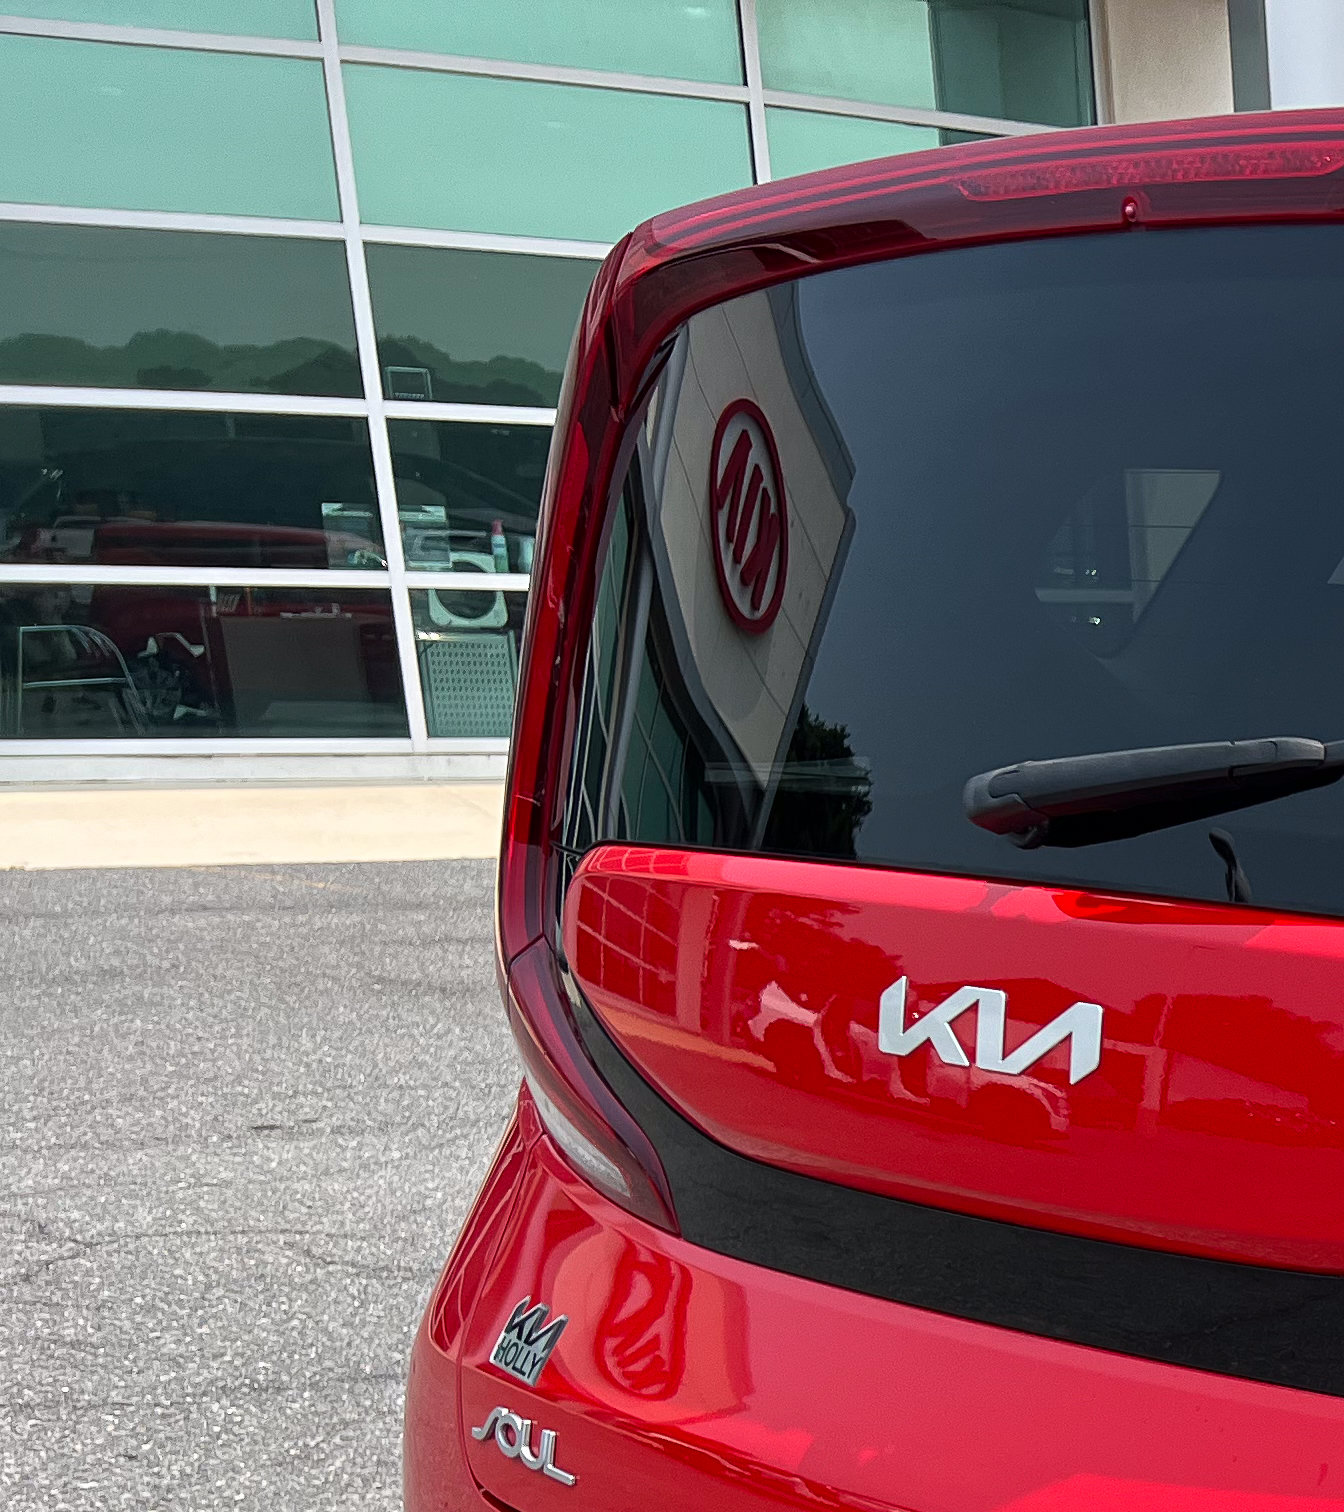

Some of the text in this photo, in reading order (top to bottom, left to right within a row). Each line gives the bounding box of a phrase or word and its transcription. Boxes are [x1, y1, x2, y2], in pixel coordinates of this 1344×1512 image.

[878, 975, 1104, 1085] KIA
[493, 1335, 544, 1379] HOLLY
[504, 1295, 570, 1354] KIA
[471, 1406, 576, 1487] SOUL
